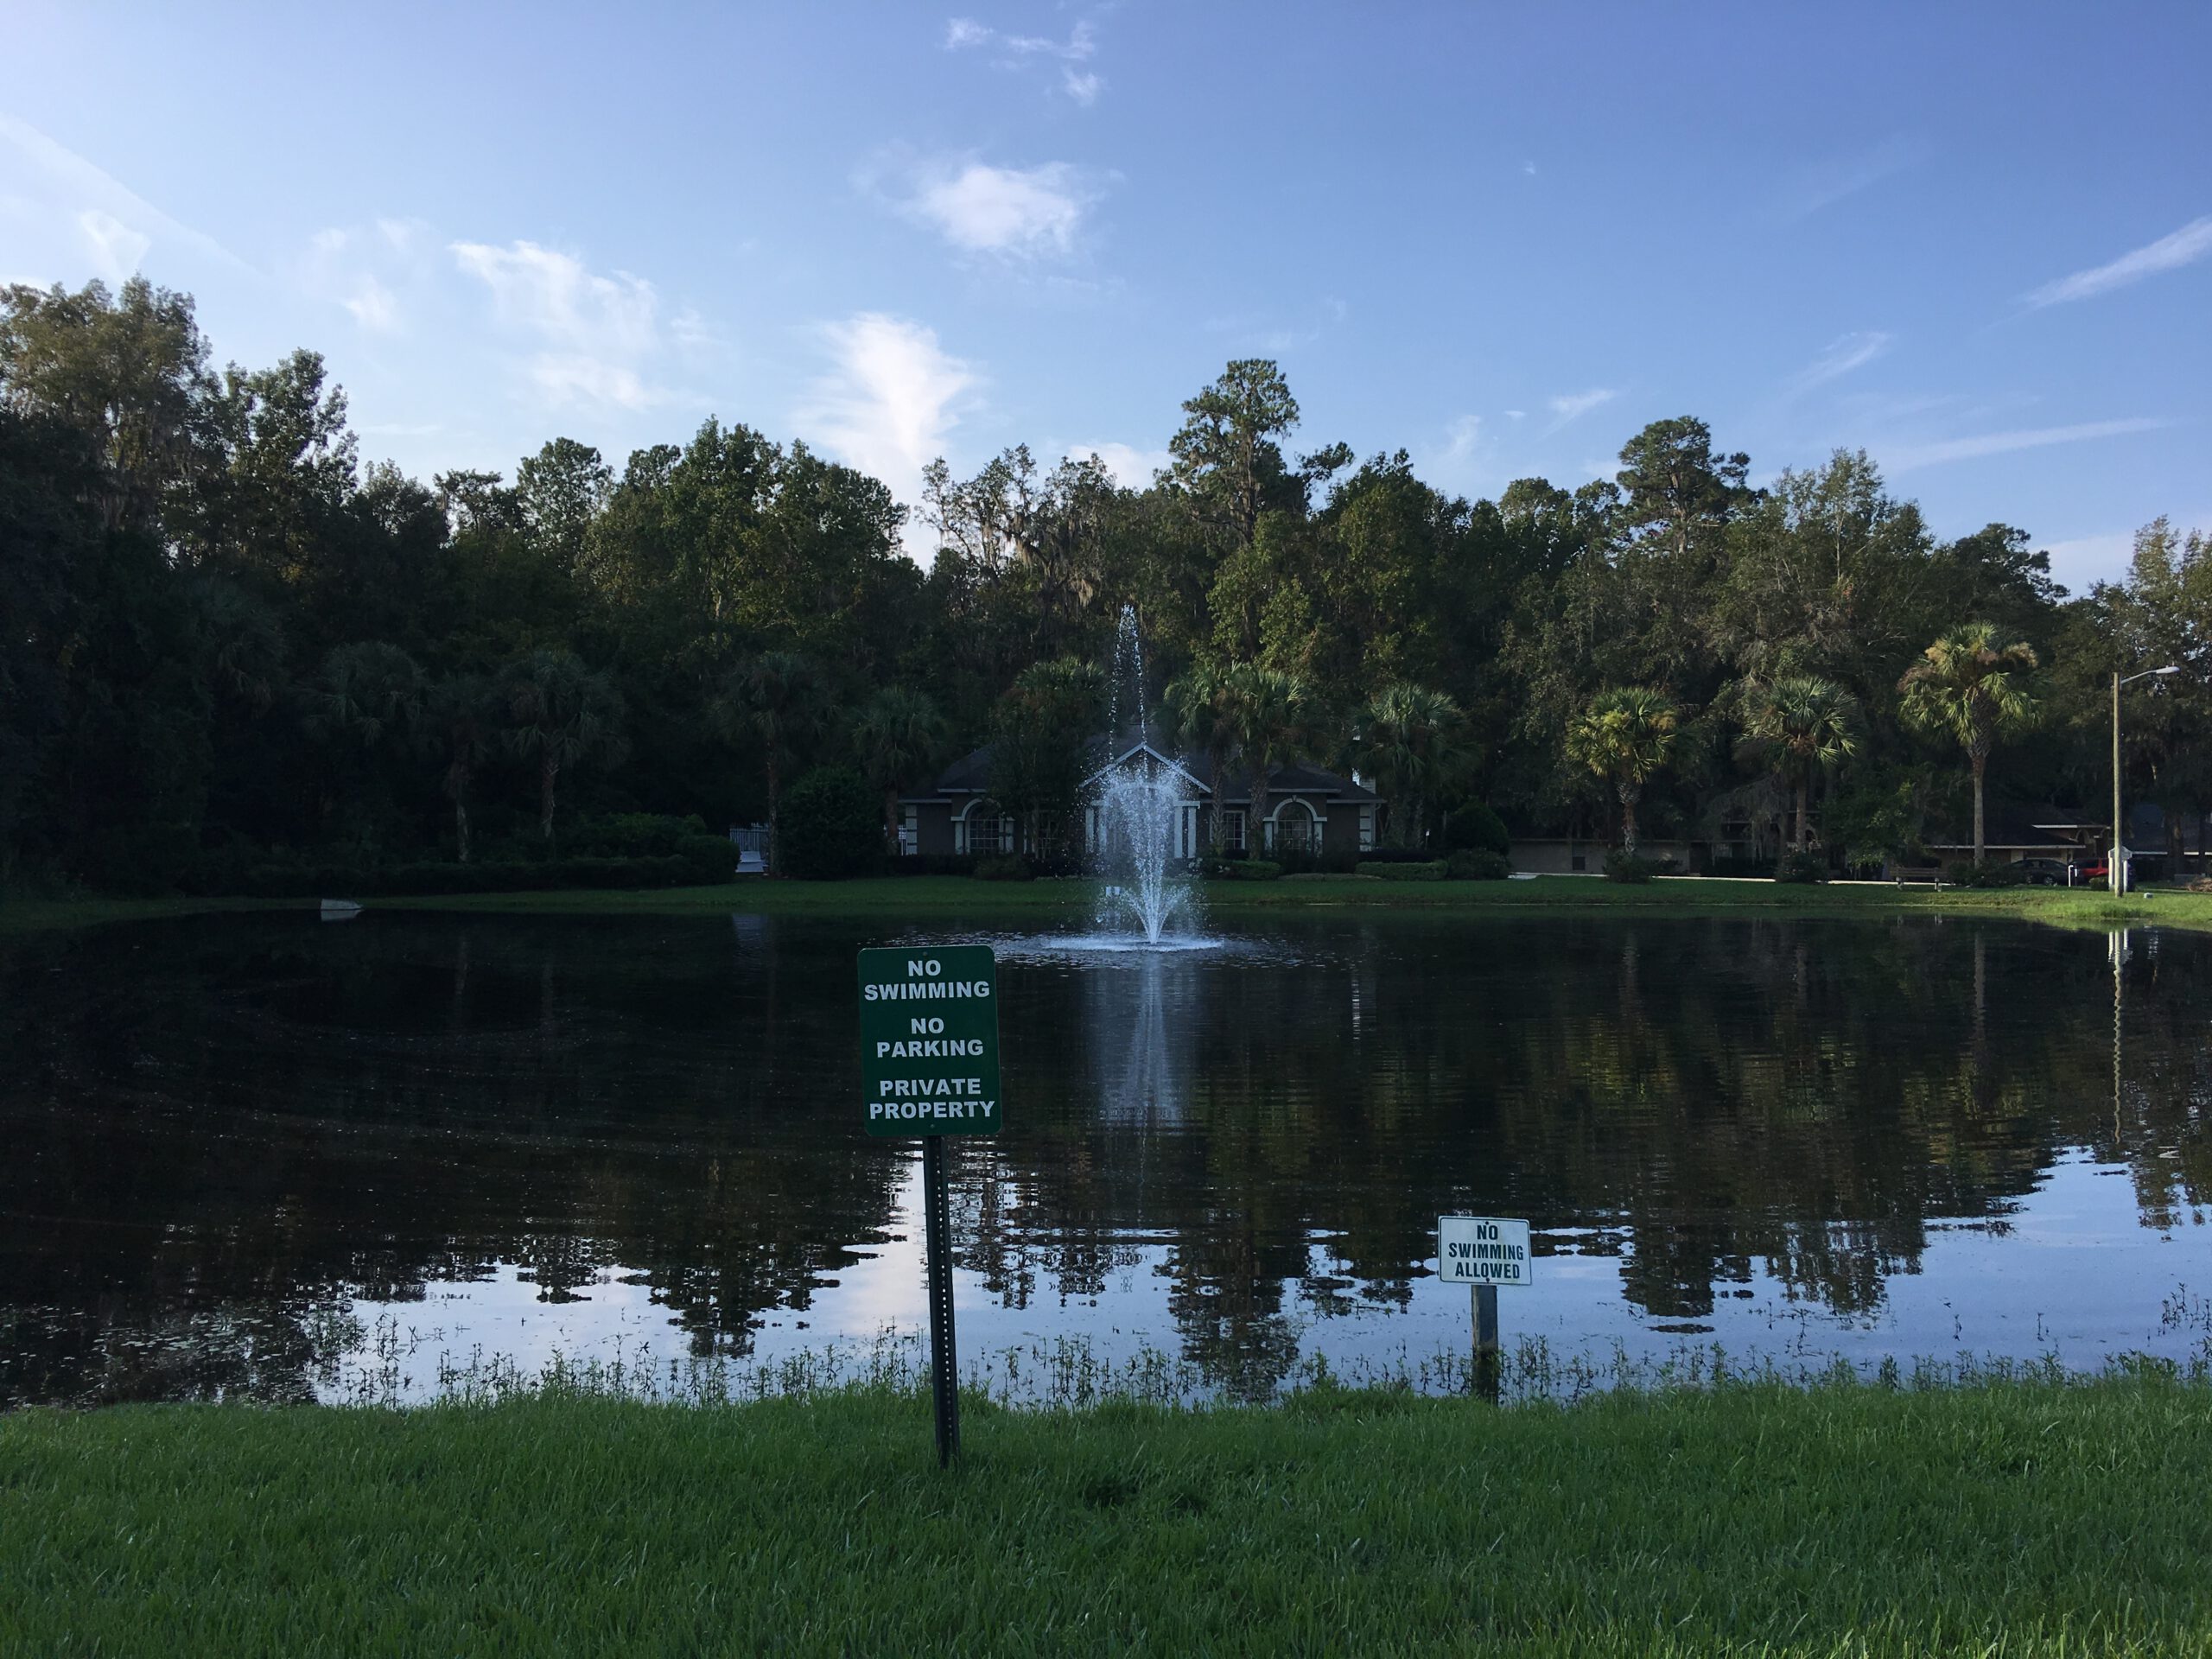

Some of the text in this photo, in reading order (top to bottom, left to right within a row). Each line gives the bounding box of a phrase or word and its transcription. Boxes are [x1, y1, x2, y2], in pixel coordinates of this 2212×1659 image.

[908, 960, 941, 976] NO
[864, 981, 990, 1001] SWIMMING
[911, 1018, 944, 1034] NO
[877, 1039, 983, 1058] PARKING
[880, 1078, 982, 1096] PRIVATE
[869, 1101, 995, 1120] PROPERTY
[1477, 1225, 1498, 1240] NO
[1448, 1243, 1523, 1260] SWIMMING
[1455, 1262, 1520, 1279] ALLOWED
